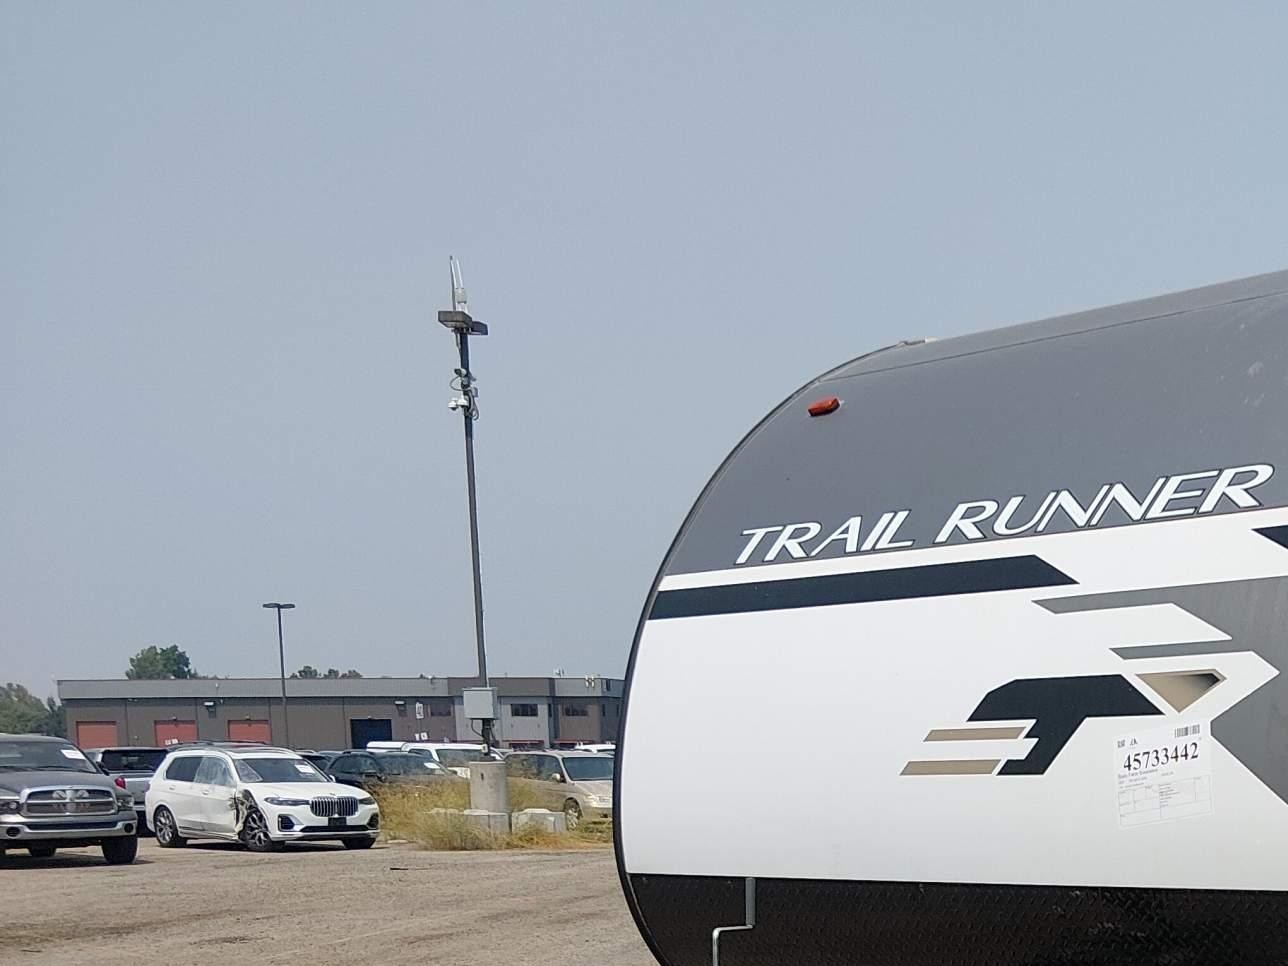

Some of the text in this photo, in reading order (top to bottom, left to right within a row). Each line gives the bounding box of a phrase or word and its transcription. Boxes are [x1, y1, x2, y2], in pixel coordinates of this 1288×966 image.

[734, 463, 1276, 565] TRAIL RUNNER
[1123, 741, 1199, 772] 45733442
